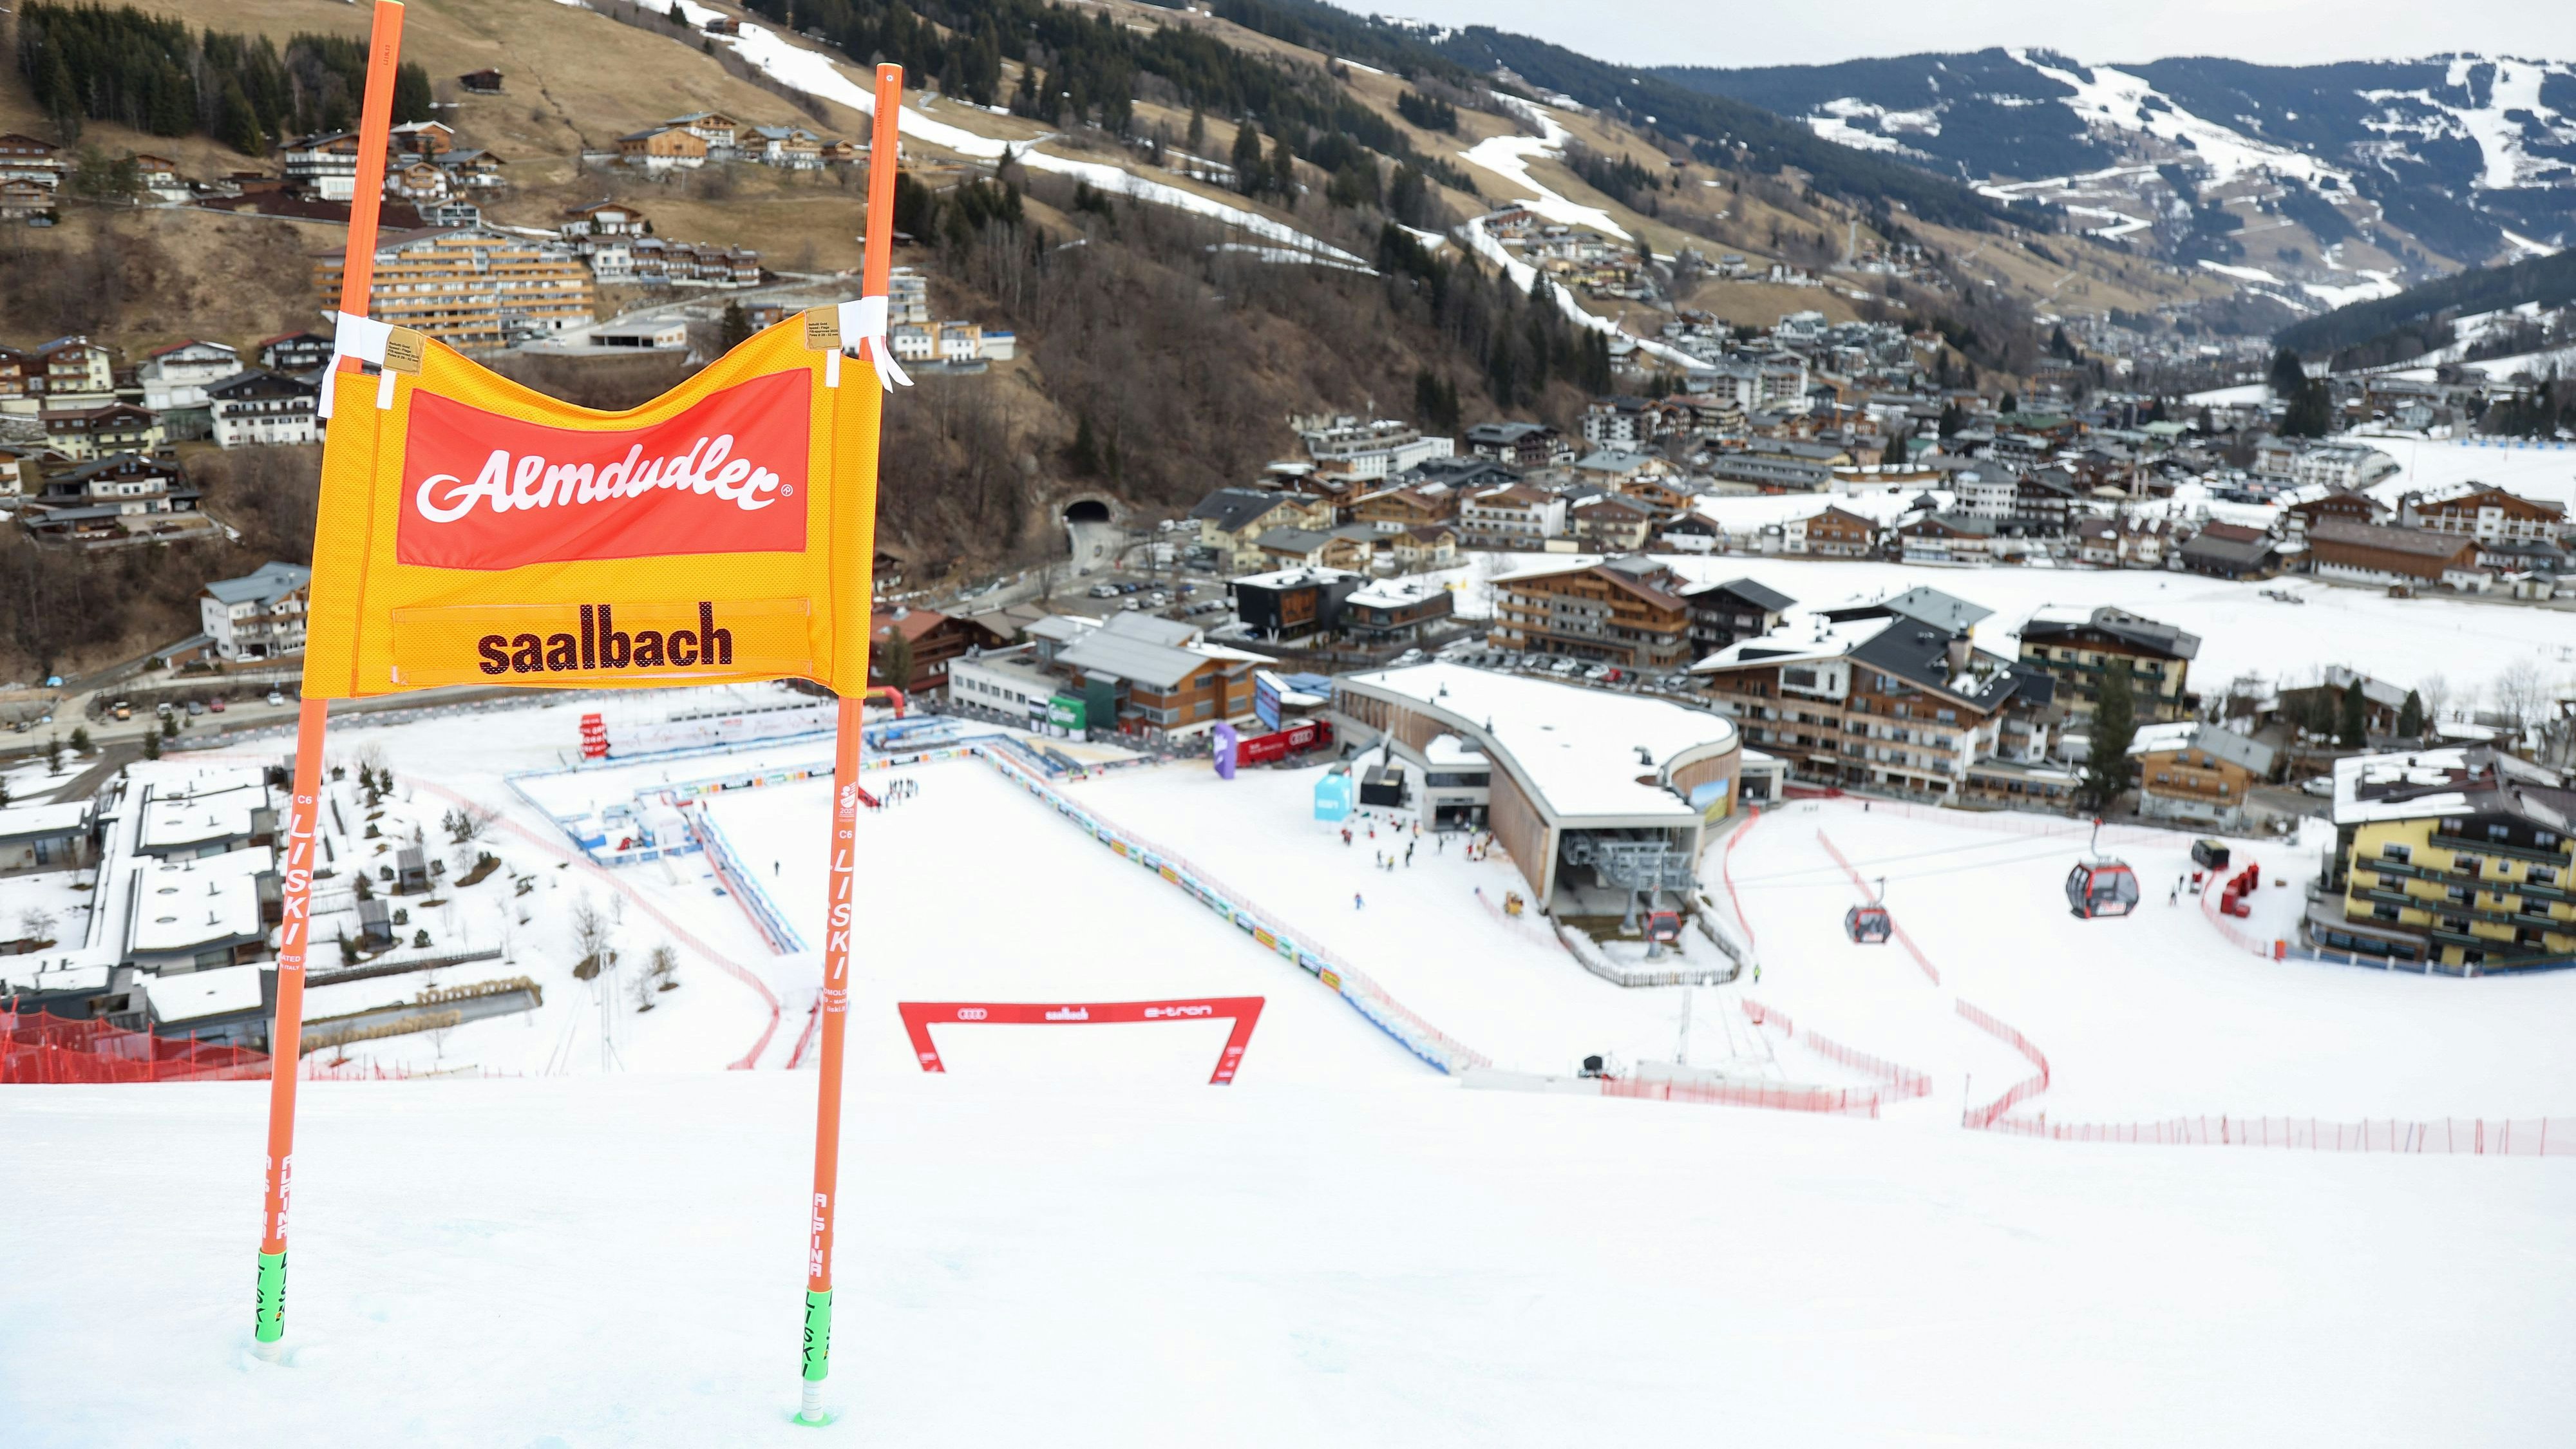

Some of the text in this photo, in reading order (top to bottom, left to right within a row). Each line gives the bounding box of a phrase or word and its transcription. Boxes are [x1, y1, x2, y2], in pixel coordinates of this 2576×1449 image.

[416, 434, 780, 523] Almdudler
[478, 601, 732, 675] saalbach
[298, 795, 312, 804] C6
[839, 830, 852, 838] C6
[283, 813, 312, 945] LISKI
[829, 849, 853, 980] LISKI
[824, 988, 847, 996] OMOLO
[1144, 1005, 1213, 1018] e-tron
[276, 1154, 292, 1240] ALPINA
[810, 1193, 827, 1277] ALPINA
[255, 1253, 265, 1338] LISKI
[802, 1291, 815, 1378] LISKI
